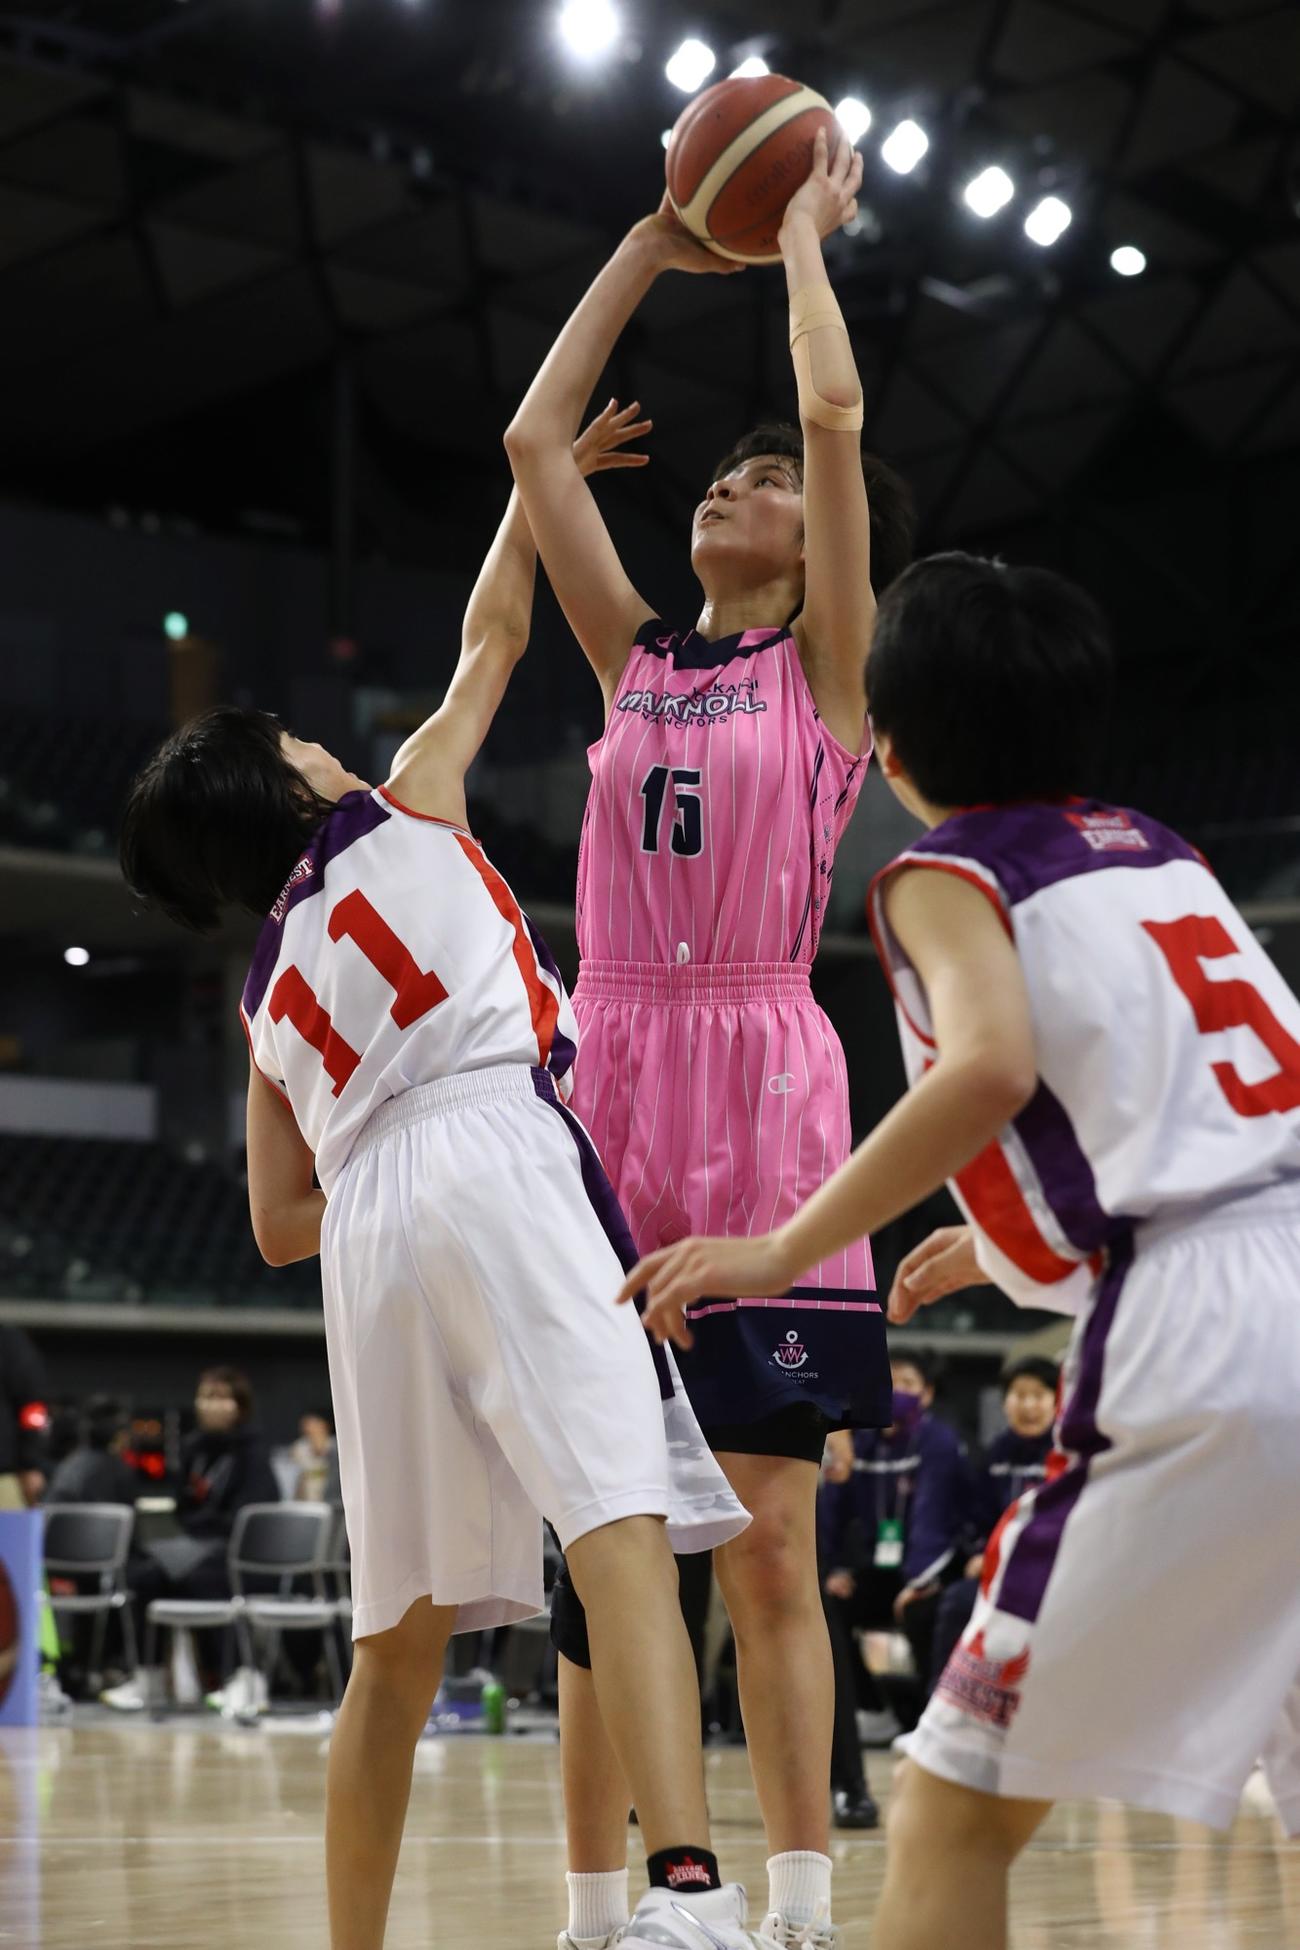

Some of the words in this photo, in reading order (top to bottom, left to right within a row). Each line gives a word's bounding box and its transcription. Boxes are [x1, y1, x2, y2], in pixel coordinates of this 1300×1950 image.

[639, 763, 704, 859] 15
[269, 857, 314, 922] EARNEST
[268, 887, 450, 1099] 11
[1139, 912, 1300, 1119] 5
[780, 1370, 819, 1379] NCHORS
